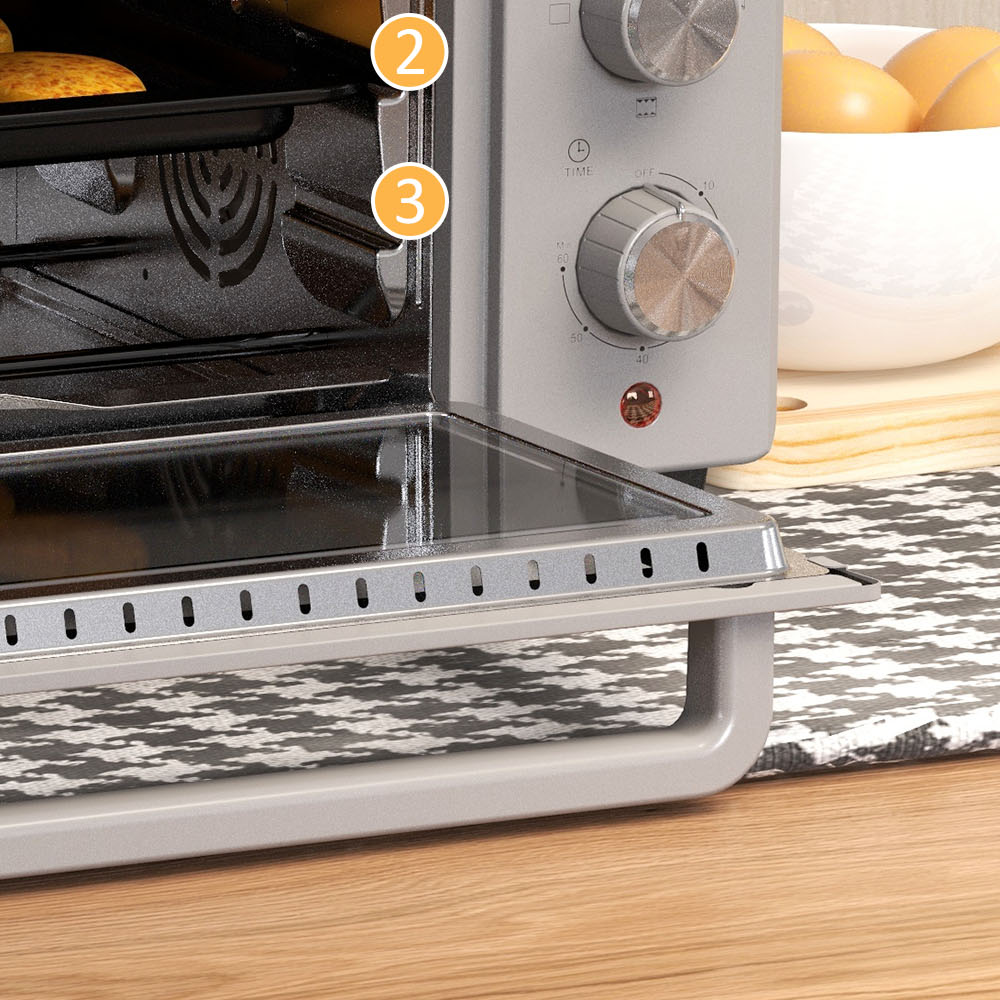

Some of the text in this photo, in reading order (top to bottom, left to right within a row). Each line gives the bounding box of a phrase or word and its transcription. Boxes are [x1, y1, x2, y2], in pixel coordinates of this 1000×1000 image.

[564, 166, 593, 177] TIME
[634, 168, 655, 178] OFF
[703, 180, 715, 191] 10
[557, 252, 569, 264] 60
[636, 354, 649, 364] 40
